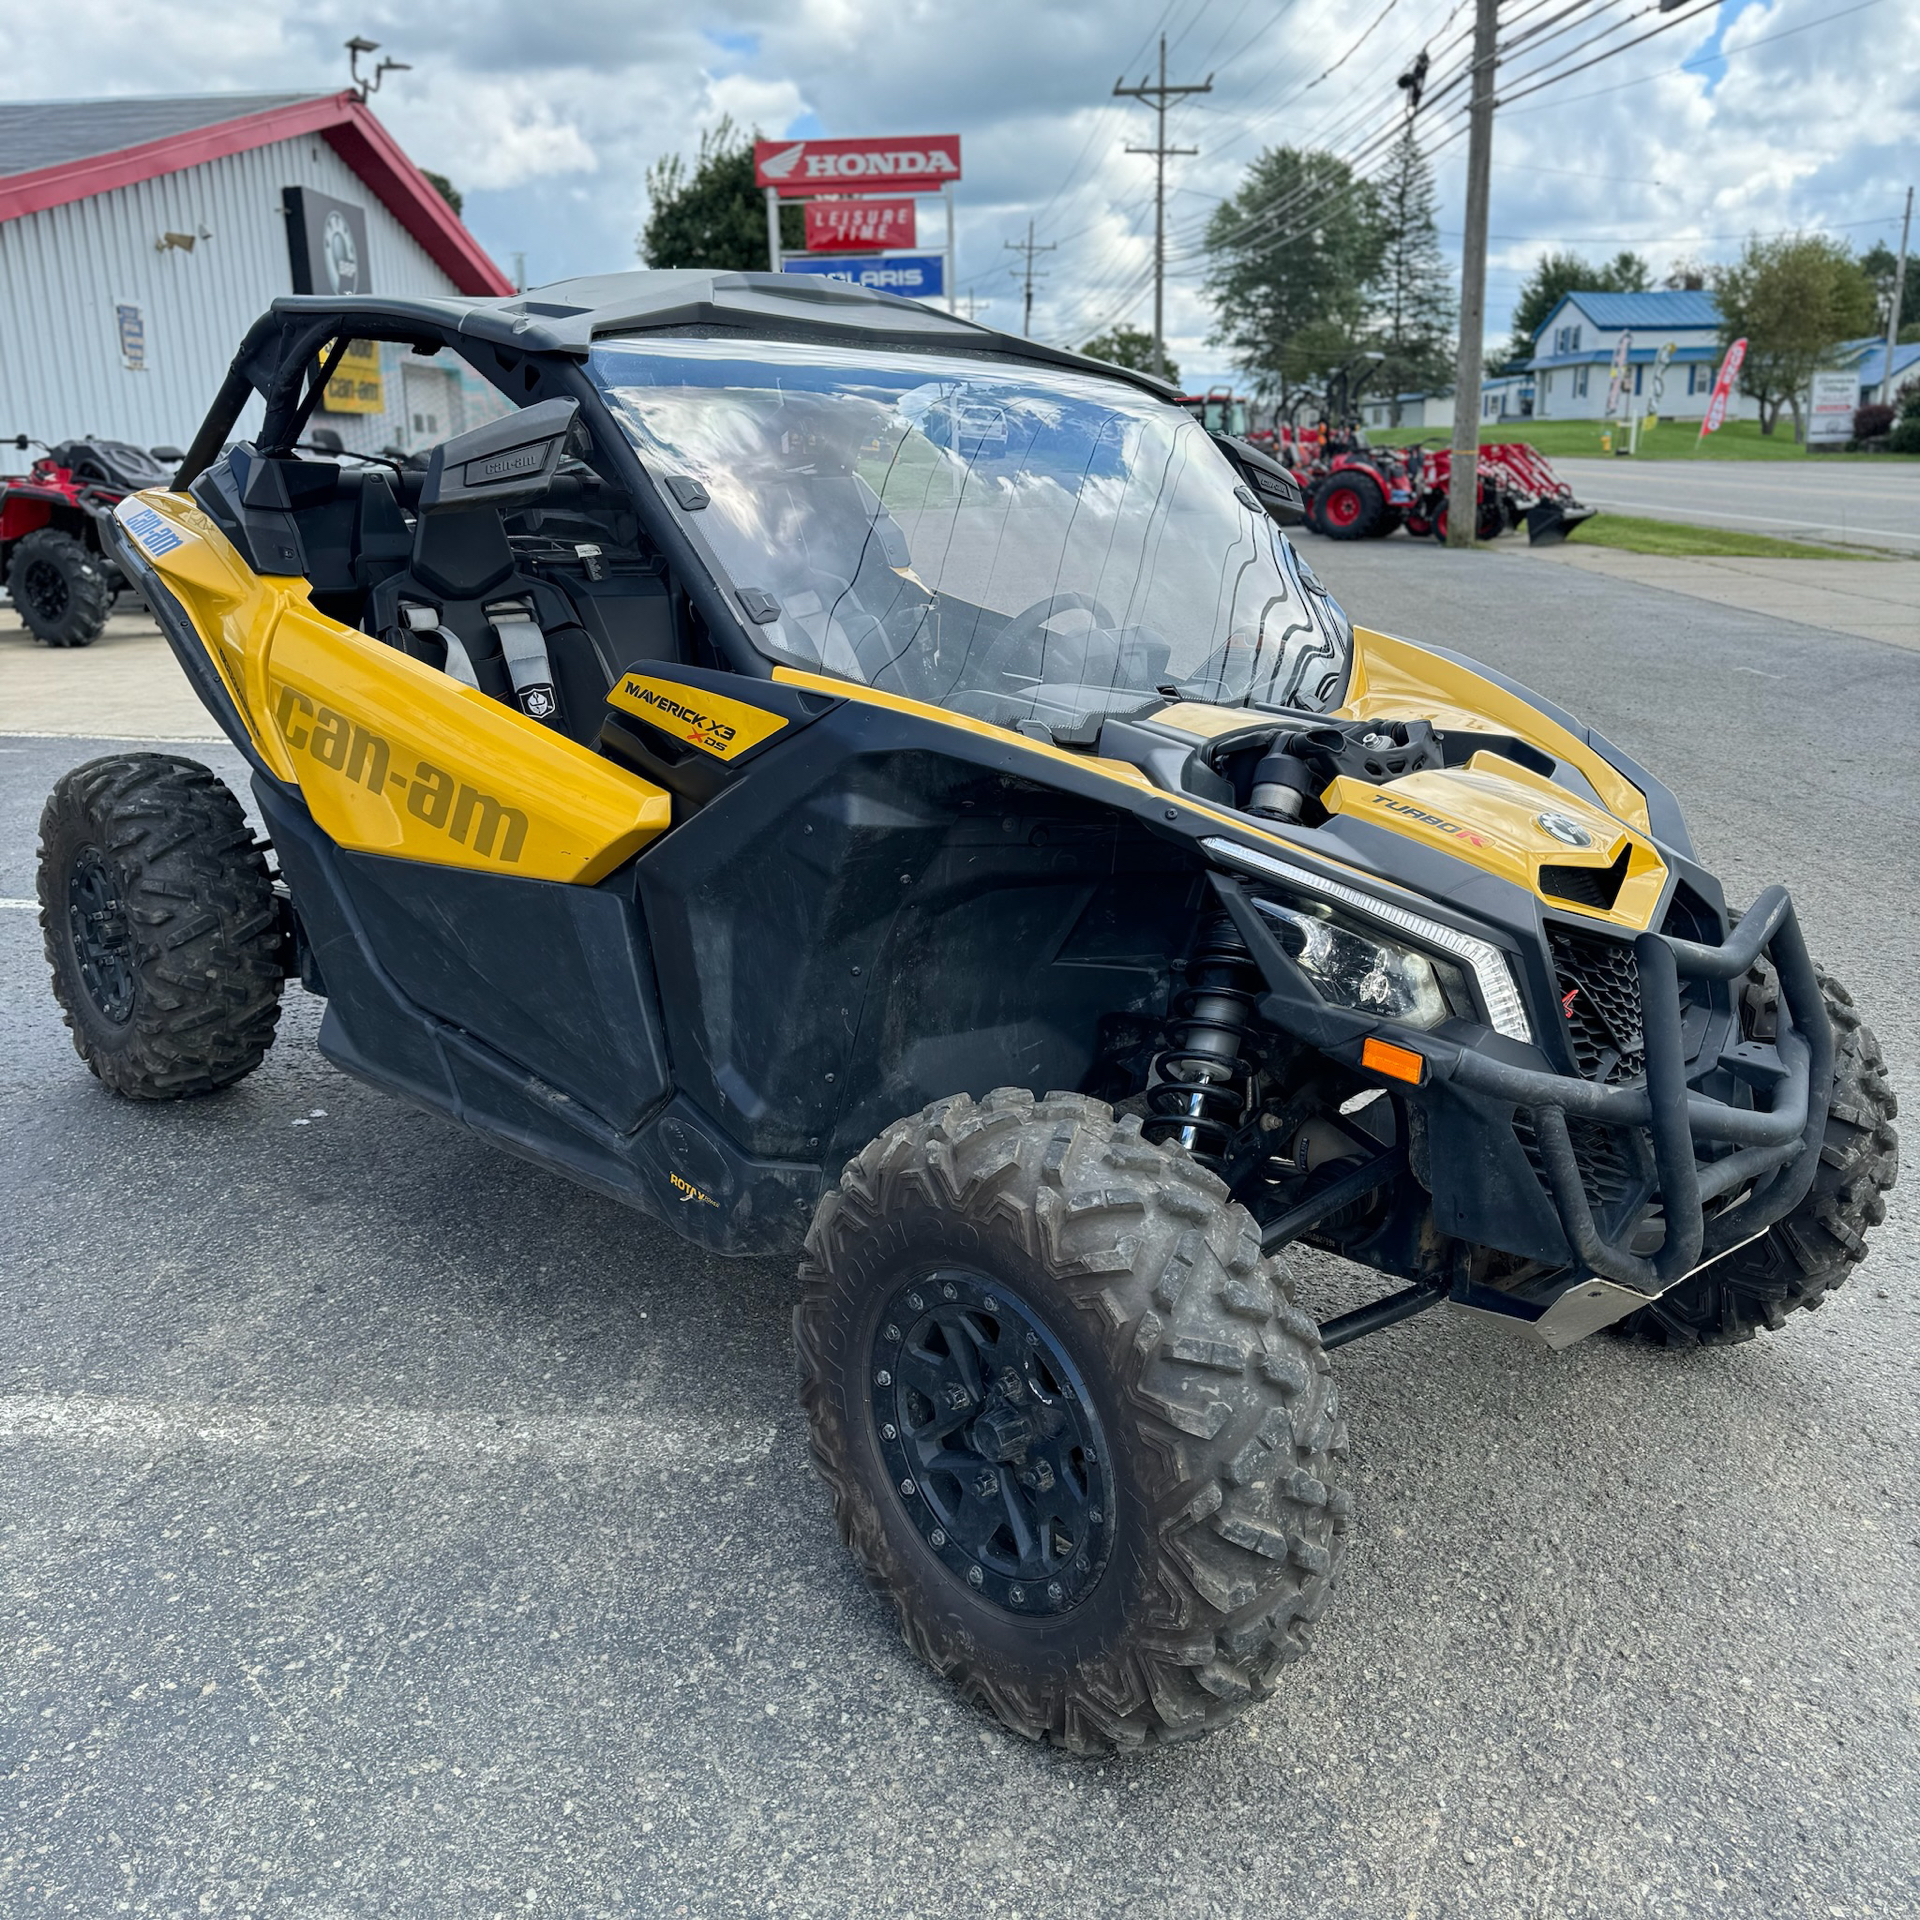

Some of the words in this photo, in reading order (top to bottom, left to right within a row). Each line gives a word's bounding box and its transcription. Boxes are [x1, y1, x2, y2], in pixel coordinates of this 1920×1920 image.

[804, 150, 958, 177] HONDA
[815, 208, 908, 227] LEISURE
[837, 225, 890, 241] TIME
[485, 455, 537, 475] can-am
[125, 508, 184, 558] can-am
[624, 680, 707, 729] MAVERICK
[705, 718, 737, 742] X3
[276, 685, 529, 863] can-am
